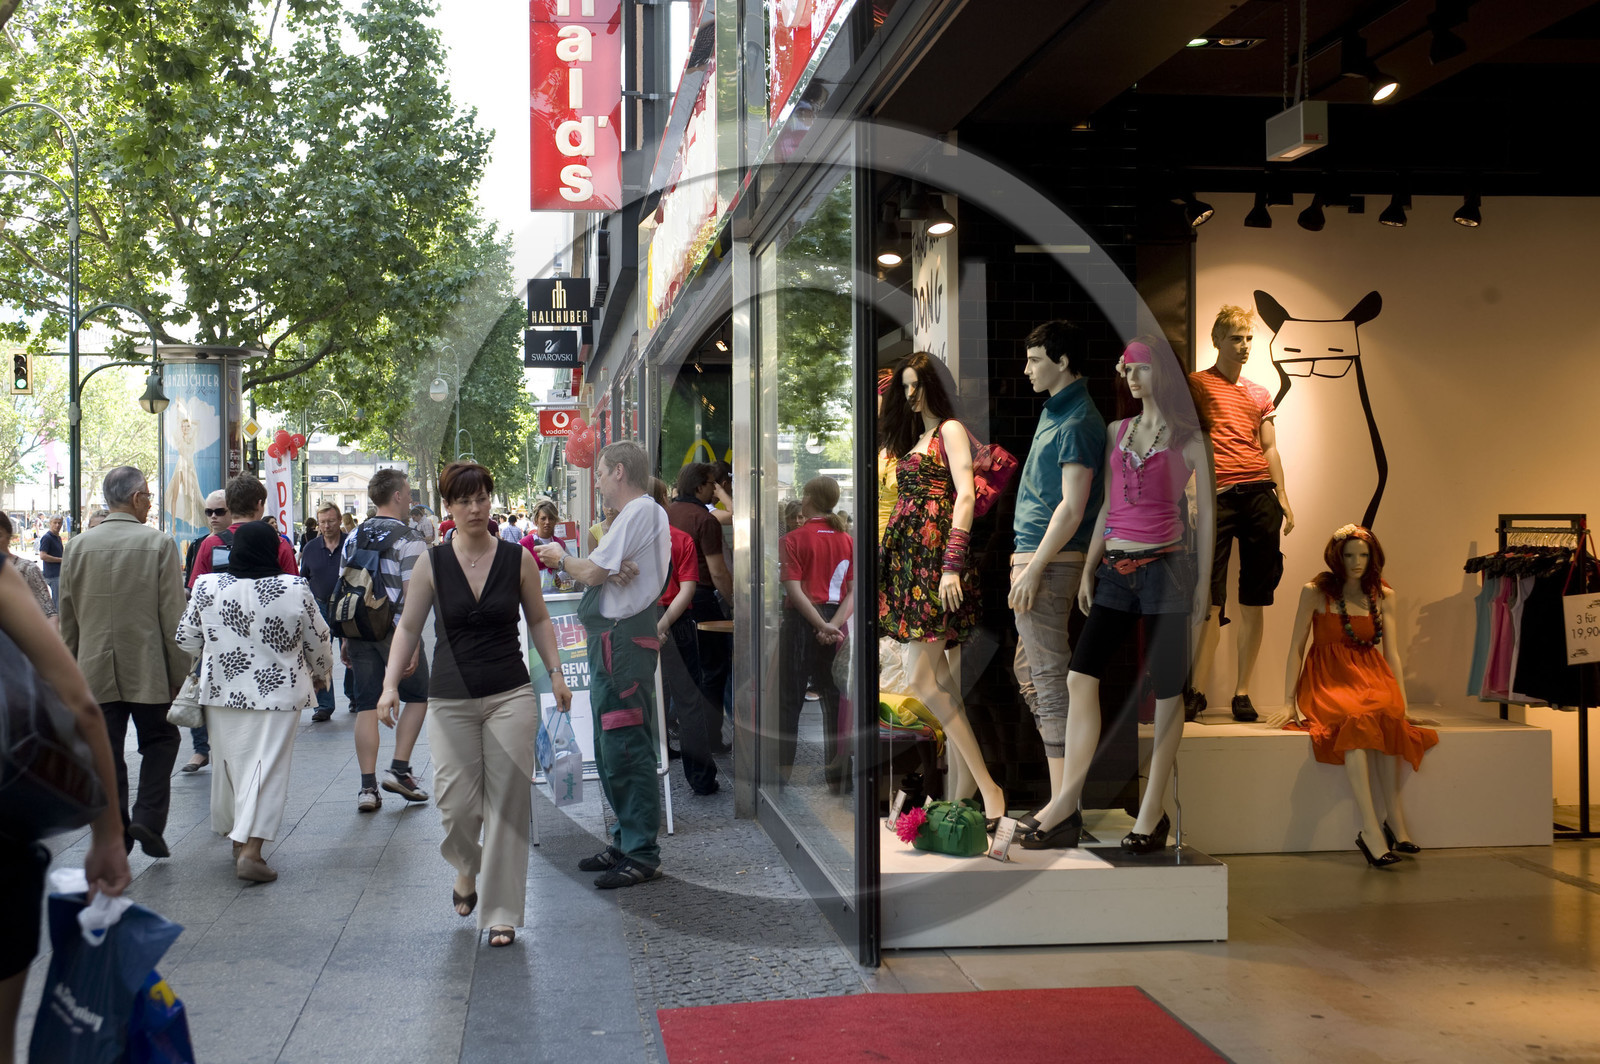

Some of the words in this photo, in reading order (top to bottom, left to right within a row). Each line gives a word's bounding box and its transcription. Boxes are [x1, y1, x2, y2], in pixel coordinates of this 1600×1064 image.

[531, 310, 588, 324] HALLHUBER
[531, 353, 573, 361] SWAROVSKI
[1576, 614, 1583, 625] 3
[1585, 612, 1597, 624] für
[1571, 626, 1600, 640] 19,90
[561, 662, 591, 675] GEW
